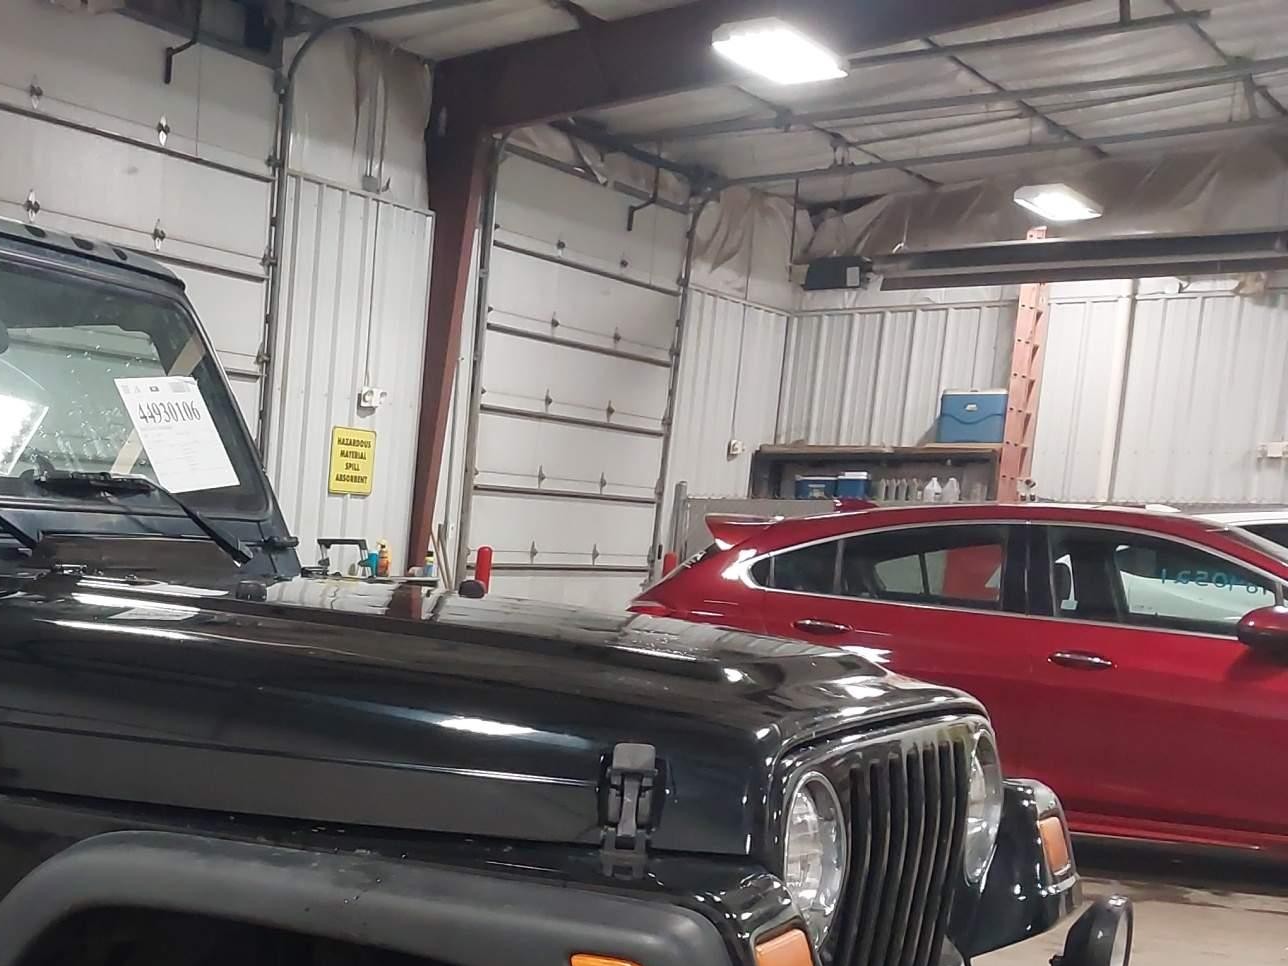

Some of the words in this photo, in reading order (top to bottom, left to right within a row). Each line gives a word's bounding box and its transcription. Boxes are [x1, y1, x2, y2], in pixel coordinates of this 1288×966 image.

[138, 401, 201, 423] 44930106
[337, 437, 371, 448] HAZARDOUS
[340, 450, 366, 460] MATERIAL
[344, 462, 360, 471] SPILL
[335, 473, 368, 484] ABSORBENT
